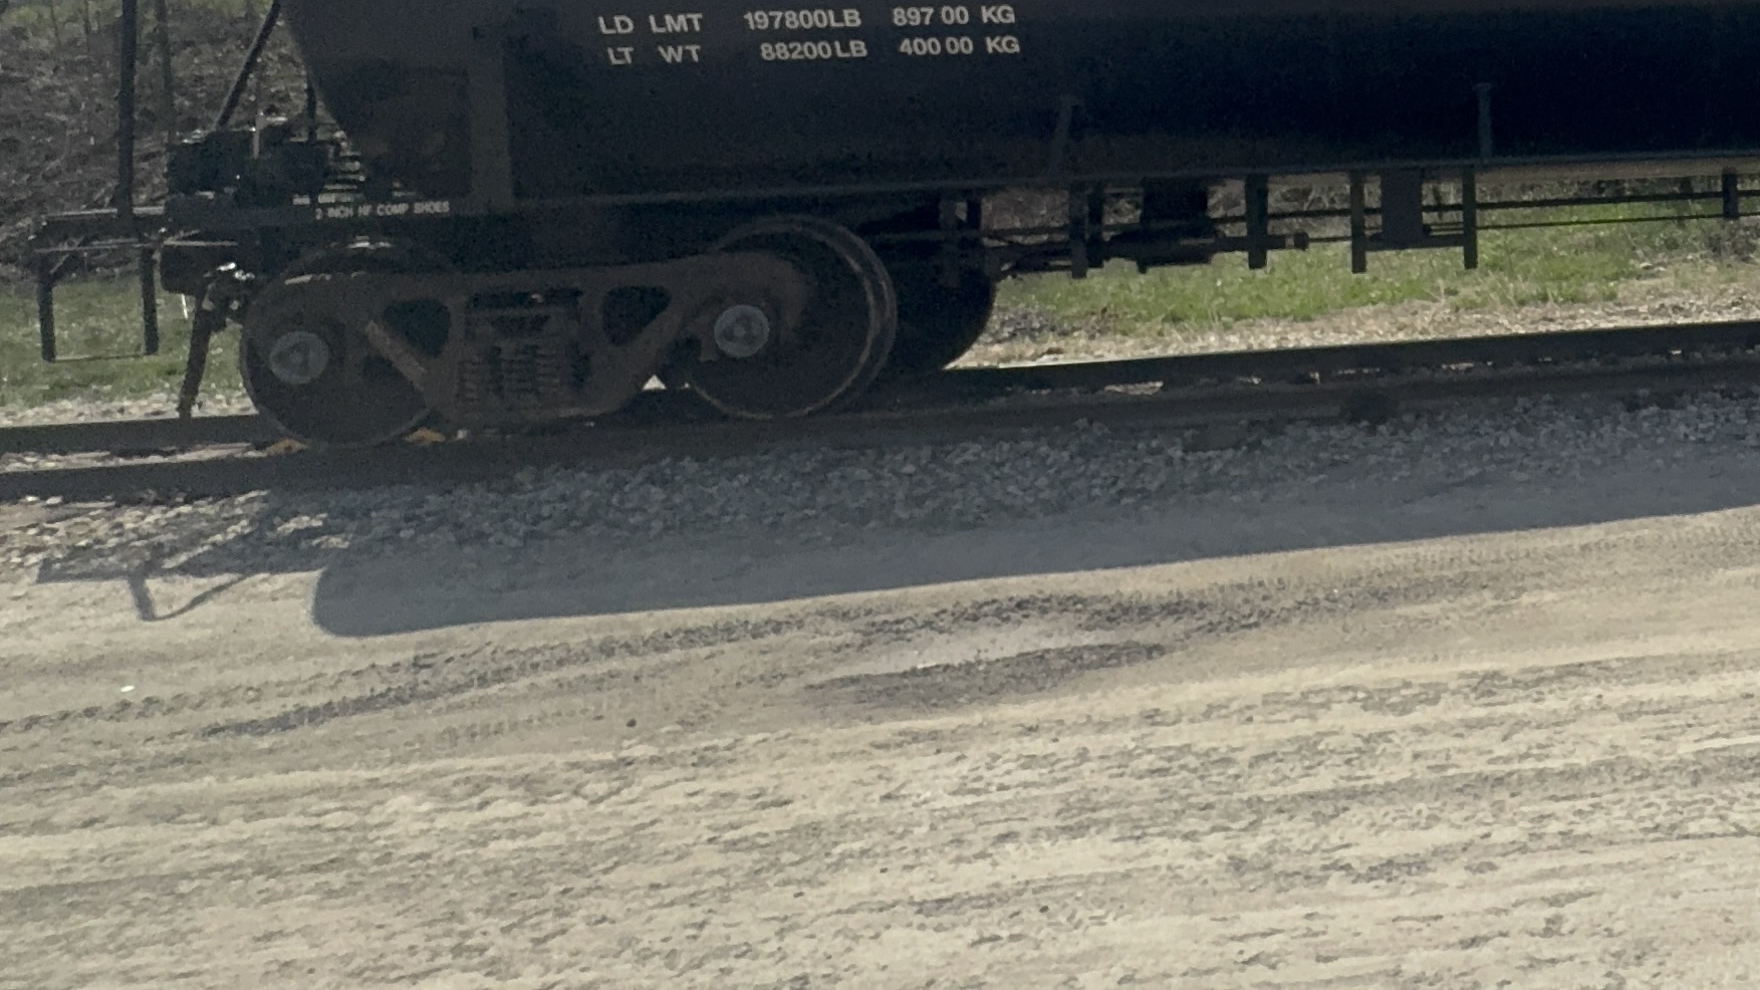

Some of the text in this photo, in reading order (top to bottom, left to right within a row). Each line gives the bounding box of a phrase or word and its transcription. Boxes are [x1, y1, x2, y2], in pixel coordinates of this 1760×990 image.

[598, 15, 634, 35] LD
[648, 13, 703, 33] LMT
[980, 4, 1016, 25] KG
[607, 46, 634, 65] LT
[657, 44, 701, 63] WT
[985, 35, 1021, 54] KG
[376, 202, 409, 216] COMP
[413, 200, 450, 214] SHOES
